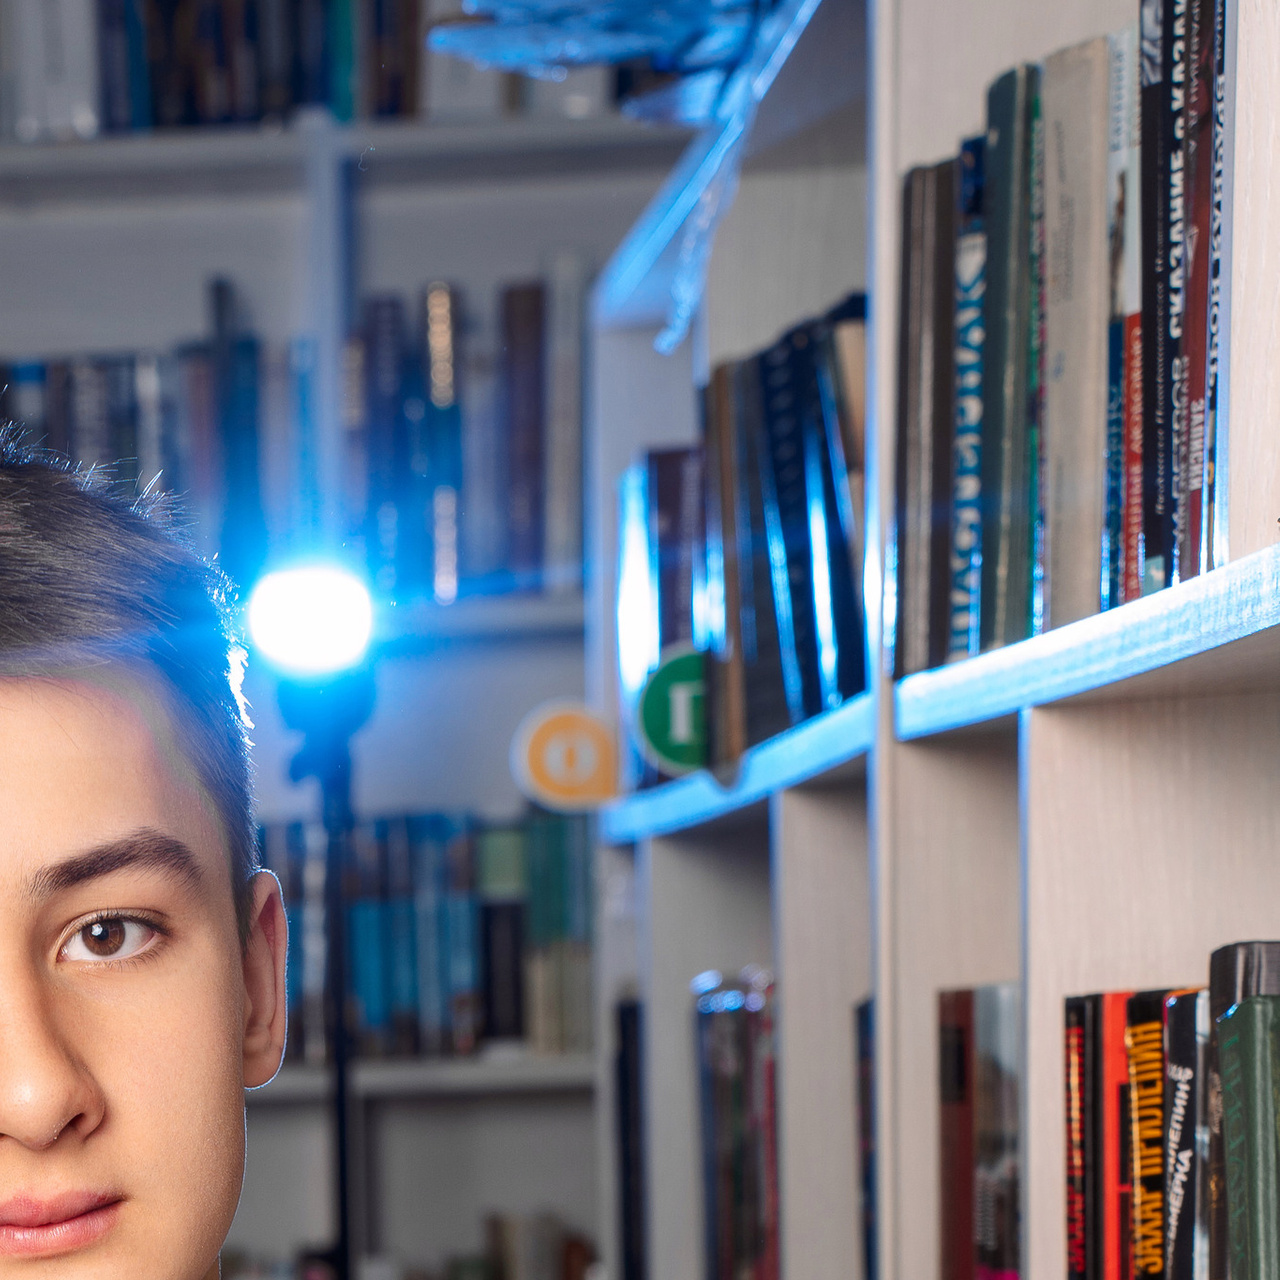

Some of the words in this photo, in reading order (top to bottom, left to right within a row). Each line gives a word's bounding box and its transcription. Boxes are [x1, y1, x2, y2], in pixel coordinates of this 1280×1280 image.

[1188, 398, 1206, 492] ЗАПИСКИ
[1125, 1020, 1163, 1176] ПРИЛЕПИН
[1130, 1188, 1163, 1274] ЗАХАР
